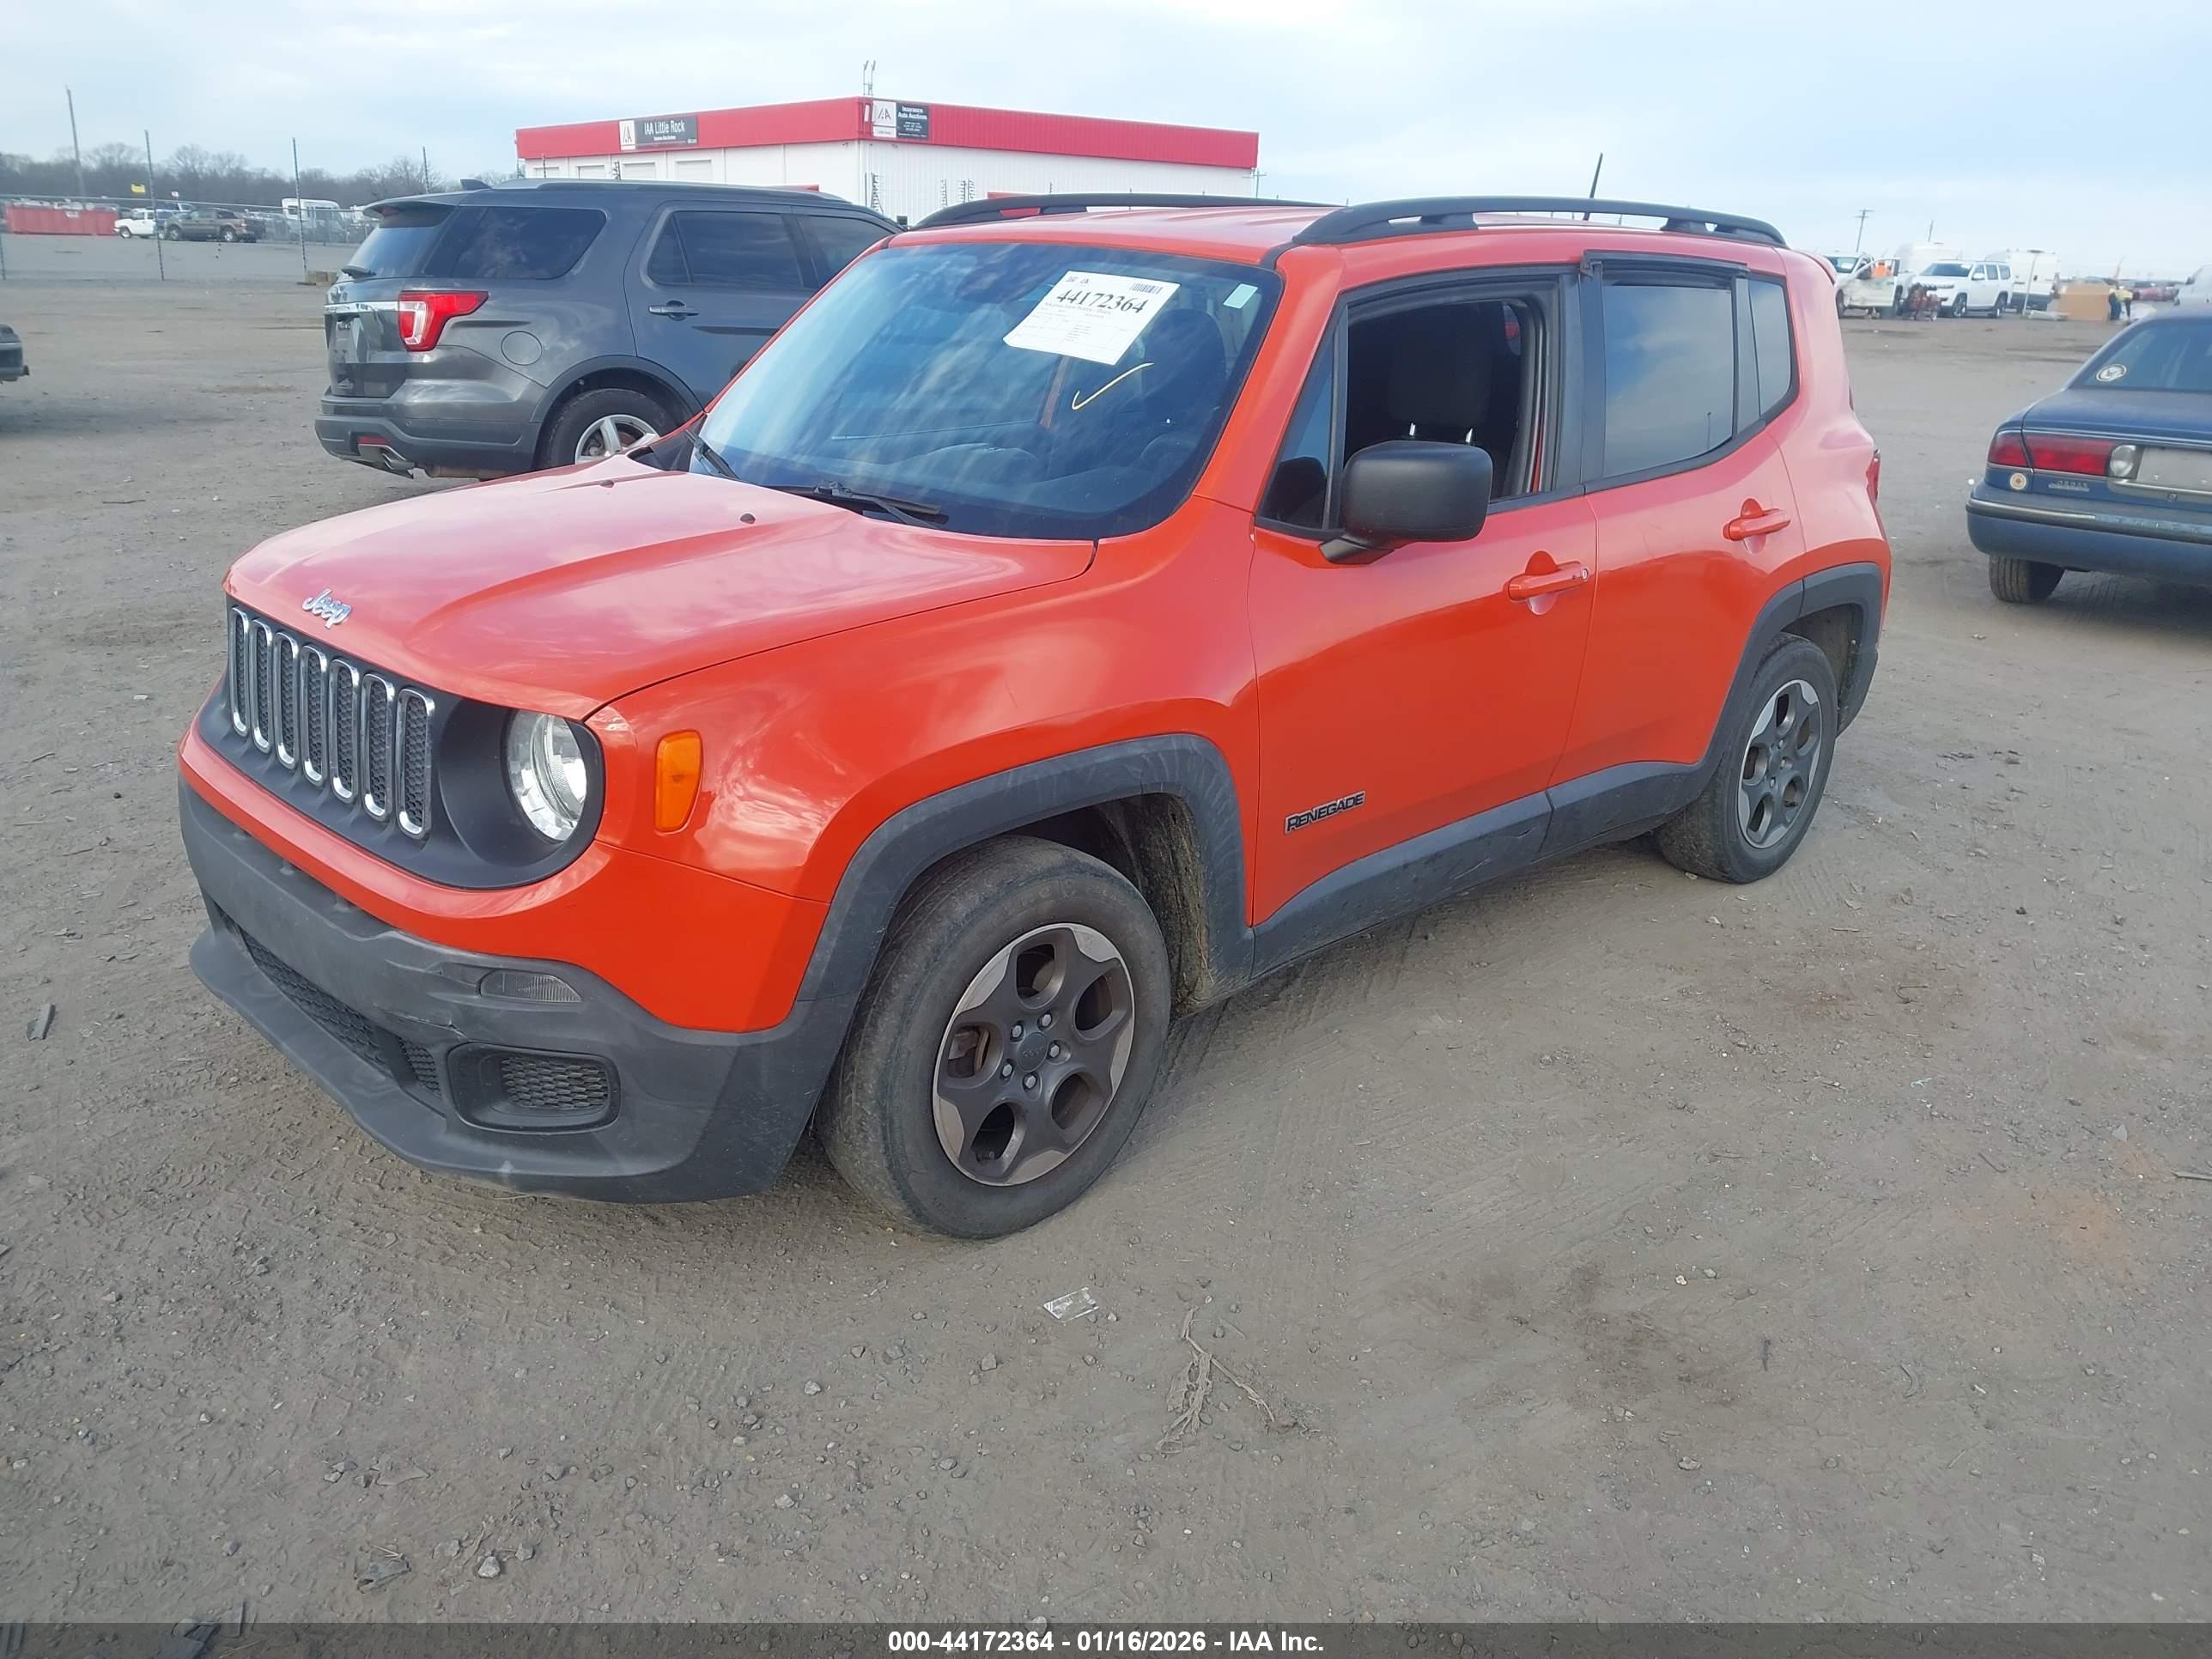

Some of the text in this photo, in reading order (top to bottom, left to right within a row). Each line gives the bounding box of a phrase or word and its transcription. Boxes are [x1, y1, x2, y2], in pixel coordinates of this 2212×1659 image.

[644, 119, 685, 136] IAA Little Rock
[1056, 289, 1149, 313] 44172364
[301, 588, 352, 629] Jeep
[1284, 790, 1365, 834] RENEGADE
